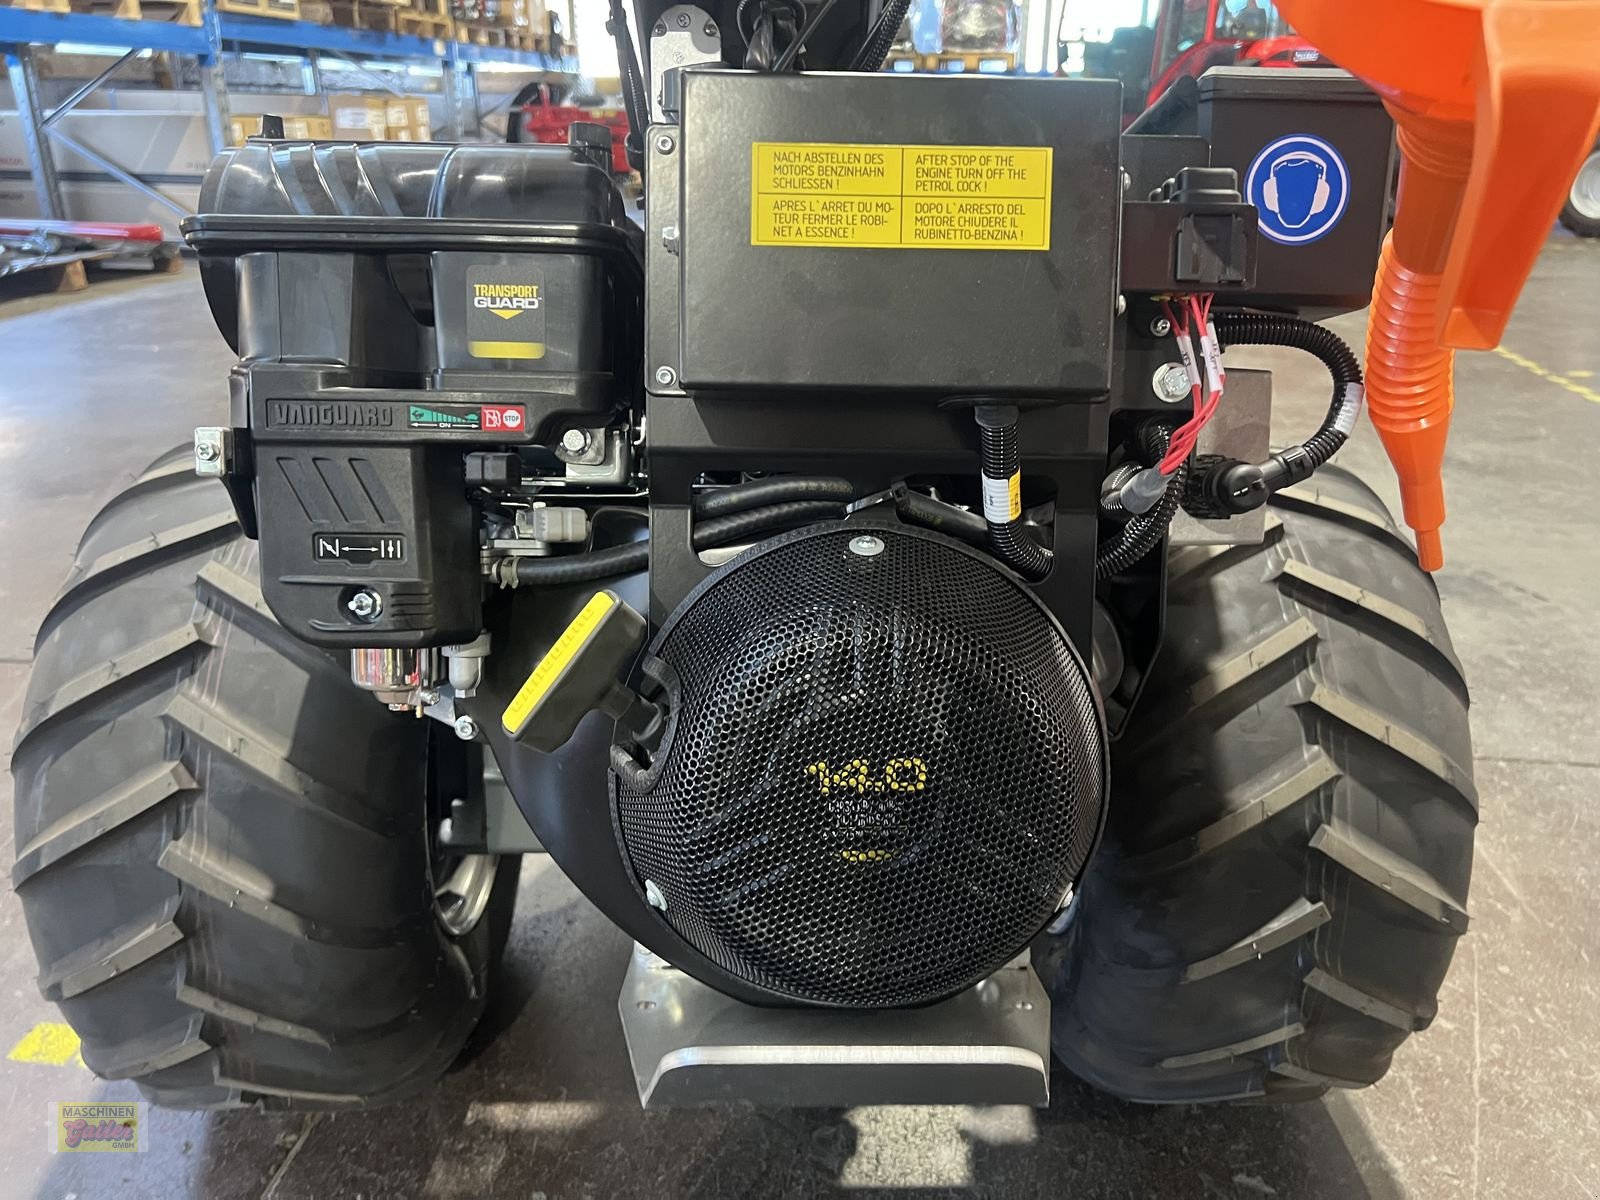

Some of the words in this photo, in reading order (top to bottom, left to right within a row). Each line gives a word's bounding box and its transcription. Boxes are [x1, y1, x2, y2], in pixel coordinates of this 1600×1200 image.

[773, 151, 801, 163] NACH
[804, 152, 861, 164] ABSTELLEN
[864, 153, 884, 165] DES
[915, 154, 948, 166] AFTER
[950, 155, 976, 166] STOP
[979, 155, 992, 166] OF
[995, 155, 1014, 167] THE
[773, 164, 815, 176] MOTORS
[818, 165, 885, 177] BENZINHAHN
[915, 167, 953, 179] ENGINE
[955, 168, 983, 179] TURN
[986, 168, 1005, 180] OFF
[1007, 168, 1027, 180] THE
[773, 177, 833, 190] SCHLIESSEN
[915, 180, 954, 192] PETROL
[956, 180, 982, 192] COCK
[773, 200, 806, 212] APRES
[821, 201, 855, 213] ARRET
[858, 201, 872, 213] DU
[875, 202, 894, 213] MO-
[915, 202, 943, 214] DOPO
[958, 203, 1004, 215] ARRESTO
[1007, 204, 1026, 215] DEL
[773, 213, 800, 224] TEUR
[802, 213, 843, 225] FERMER
[846, 214, 858, 226] LE
[860, 214, 888, 226] ROBI-
[915, 215, 955, 227] MOTORE
[958, 216, 1008, 228] CHIUDERE
[1010, 217, 1018, 228] IL
[773, 226, 793, 237] NET
[795, 226, 803, 237] A
[806, 226, 849, 238] ESSENCE
[914, 228, 1018, 240] RUBINETTO-BENZINA
[474, 284, 539, 298] TRANSPORT
[274, 402, 392, 426] VANGUARD
